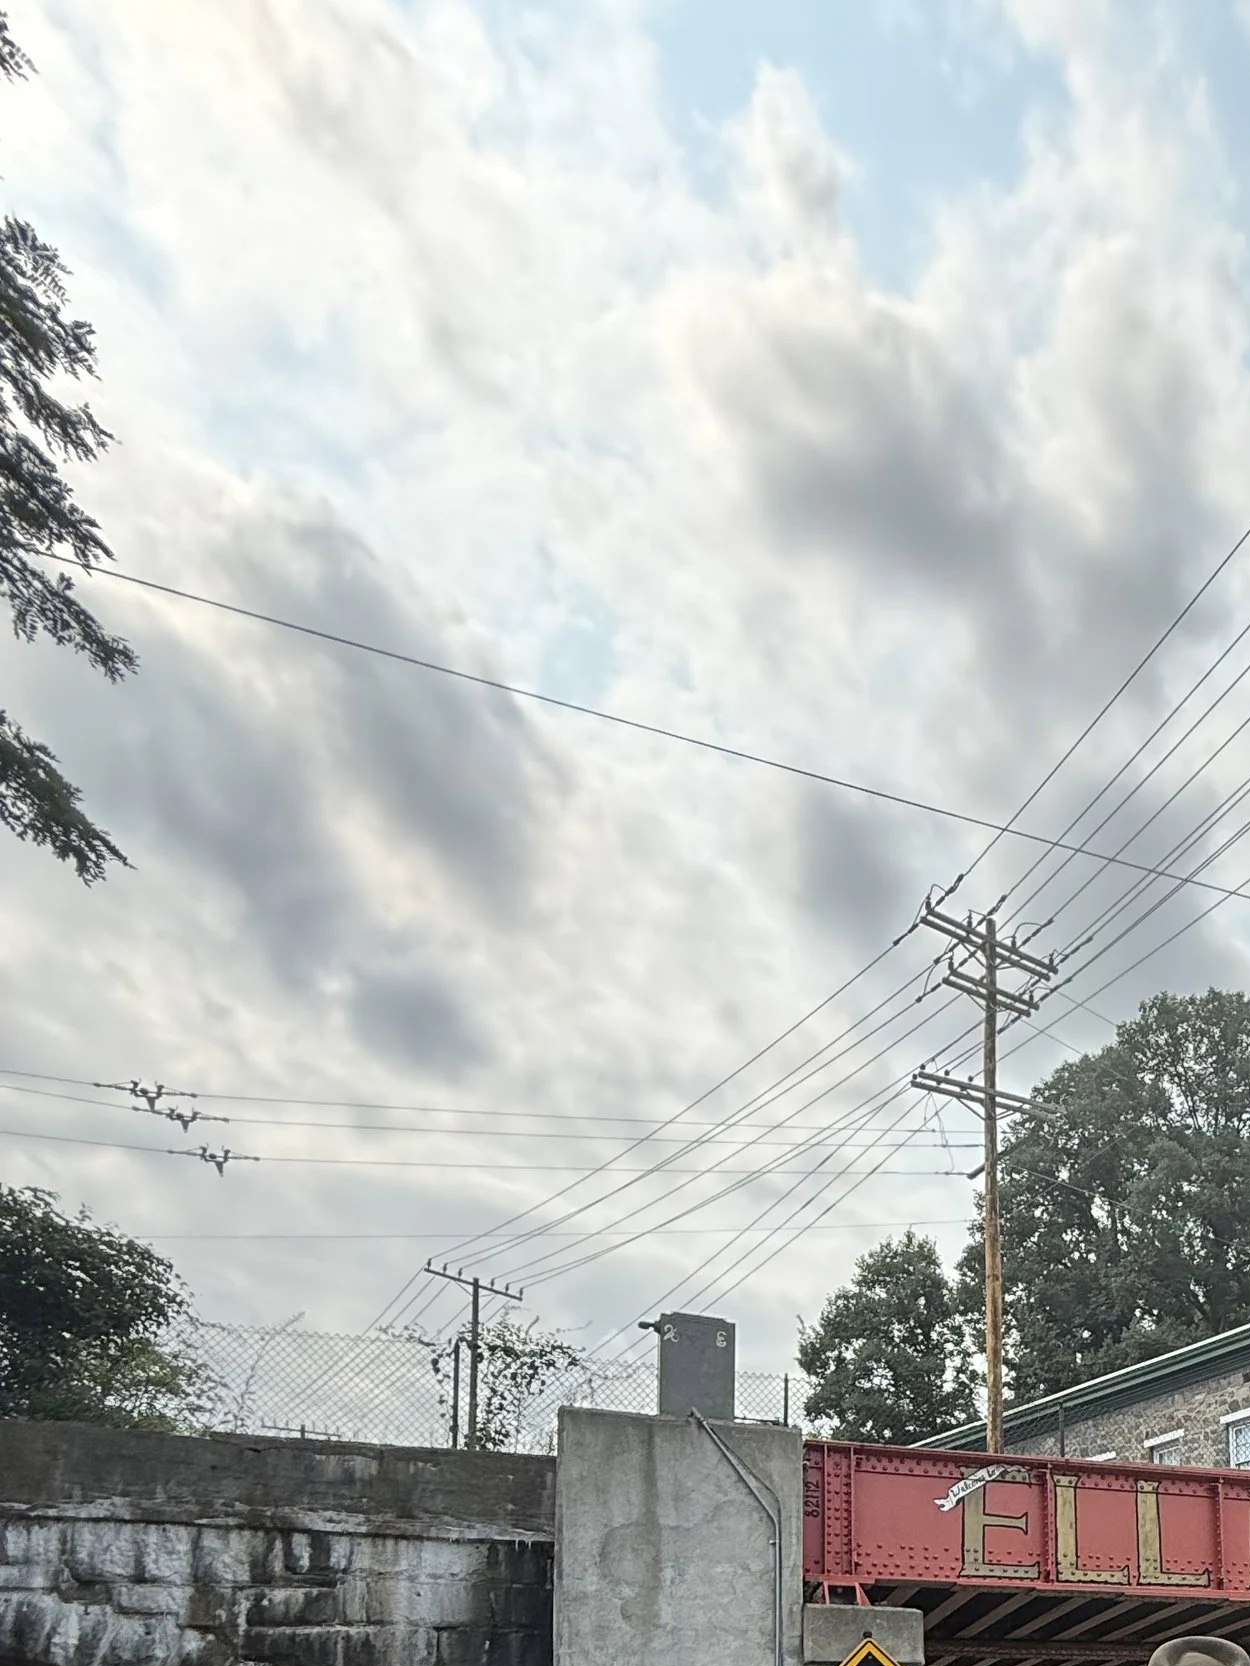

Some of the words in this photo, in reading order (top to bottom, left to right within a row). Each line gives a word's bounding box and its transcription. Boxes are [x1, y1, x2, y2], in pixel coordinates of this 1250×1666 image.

[950, 1475, 986, 1497] Welcome
[987, 1467, 996, 1478] to
[805, 1480, 820, 1519] 82112
